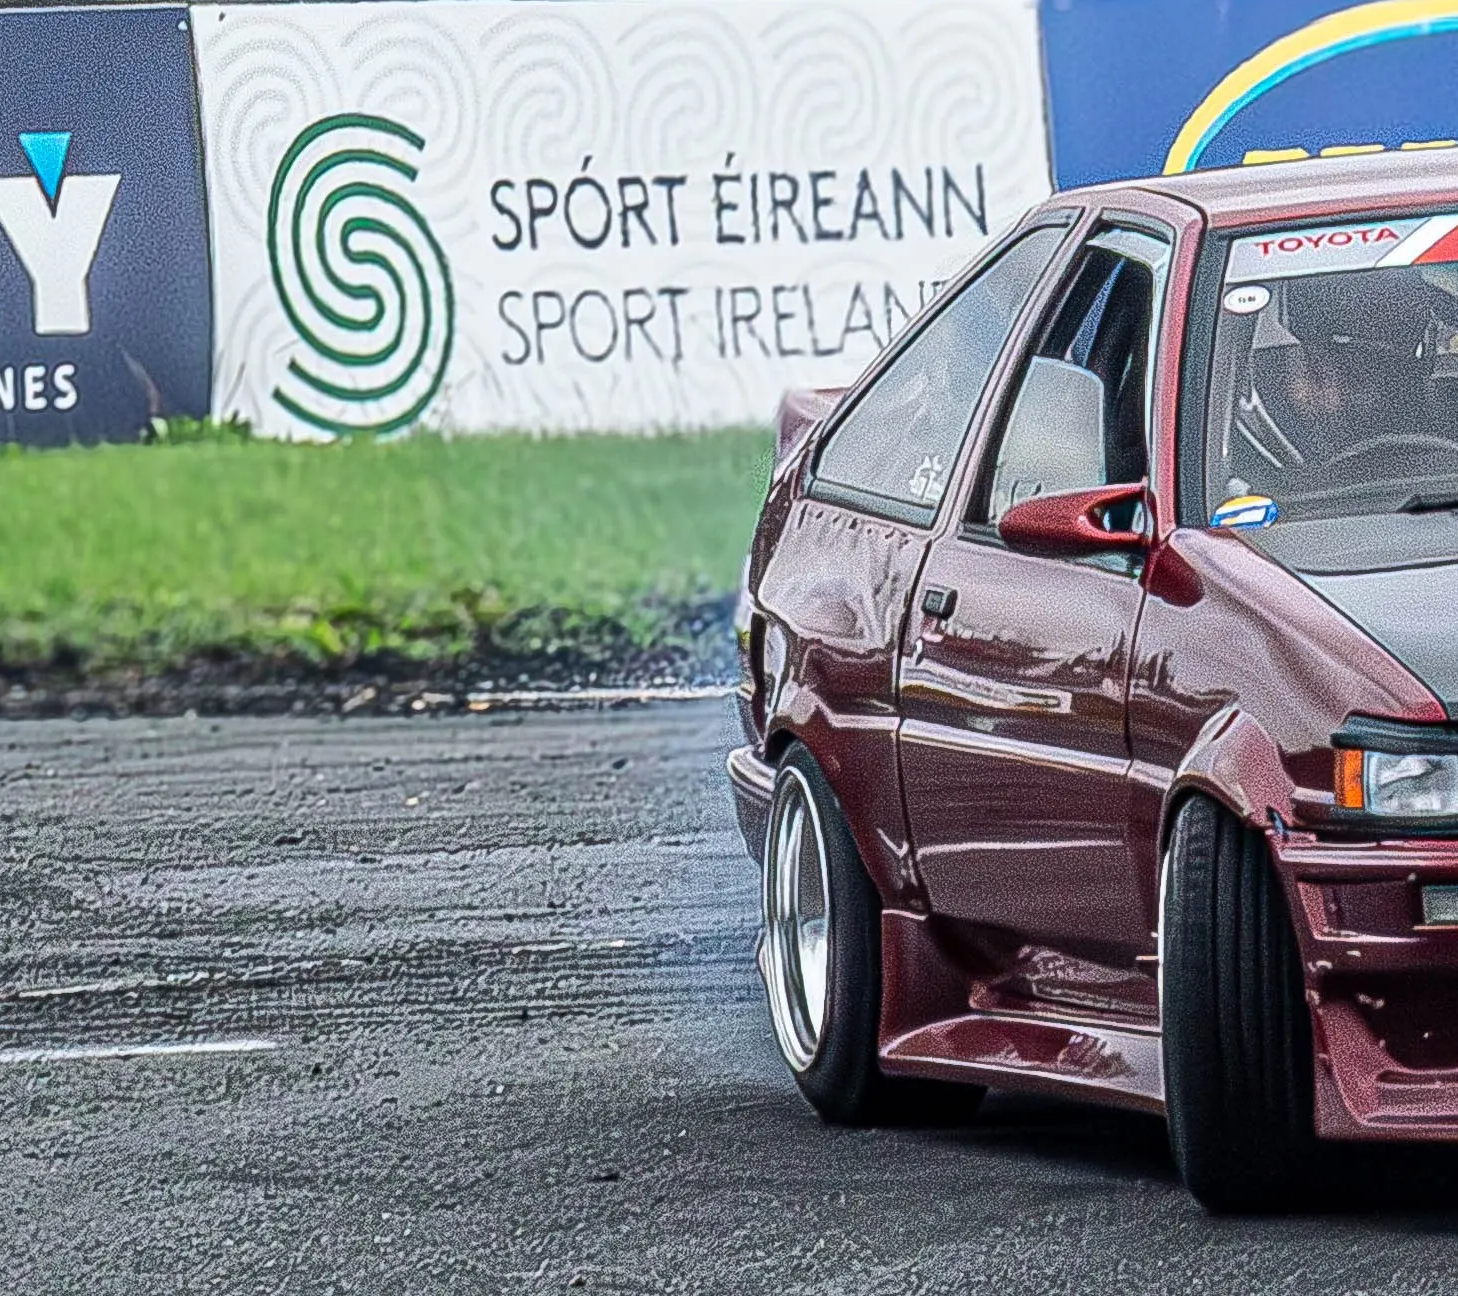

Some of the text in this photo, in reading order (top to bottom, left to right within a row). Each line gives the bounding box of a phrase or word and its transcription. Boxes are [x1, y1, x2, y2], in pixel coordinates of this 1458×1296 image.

[490, 152, 989, 250] SPÓRT ÉIREANN
[1253, 226, 1399, 257] TOYOTA
[498, 287, 690, 366] SPORT
